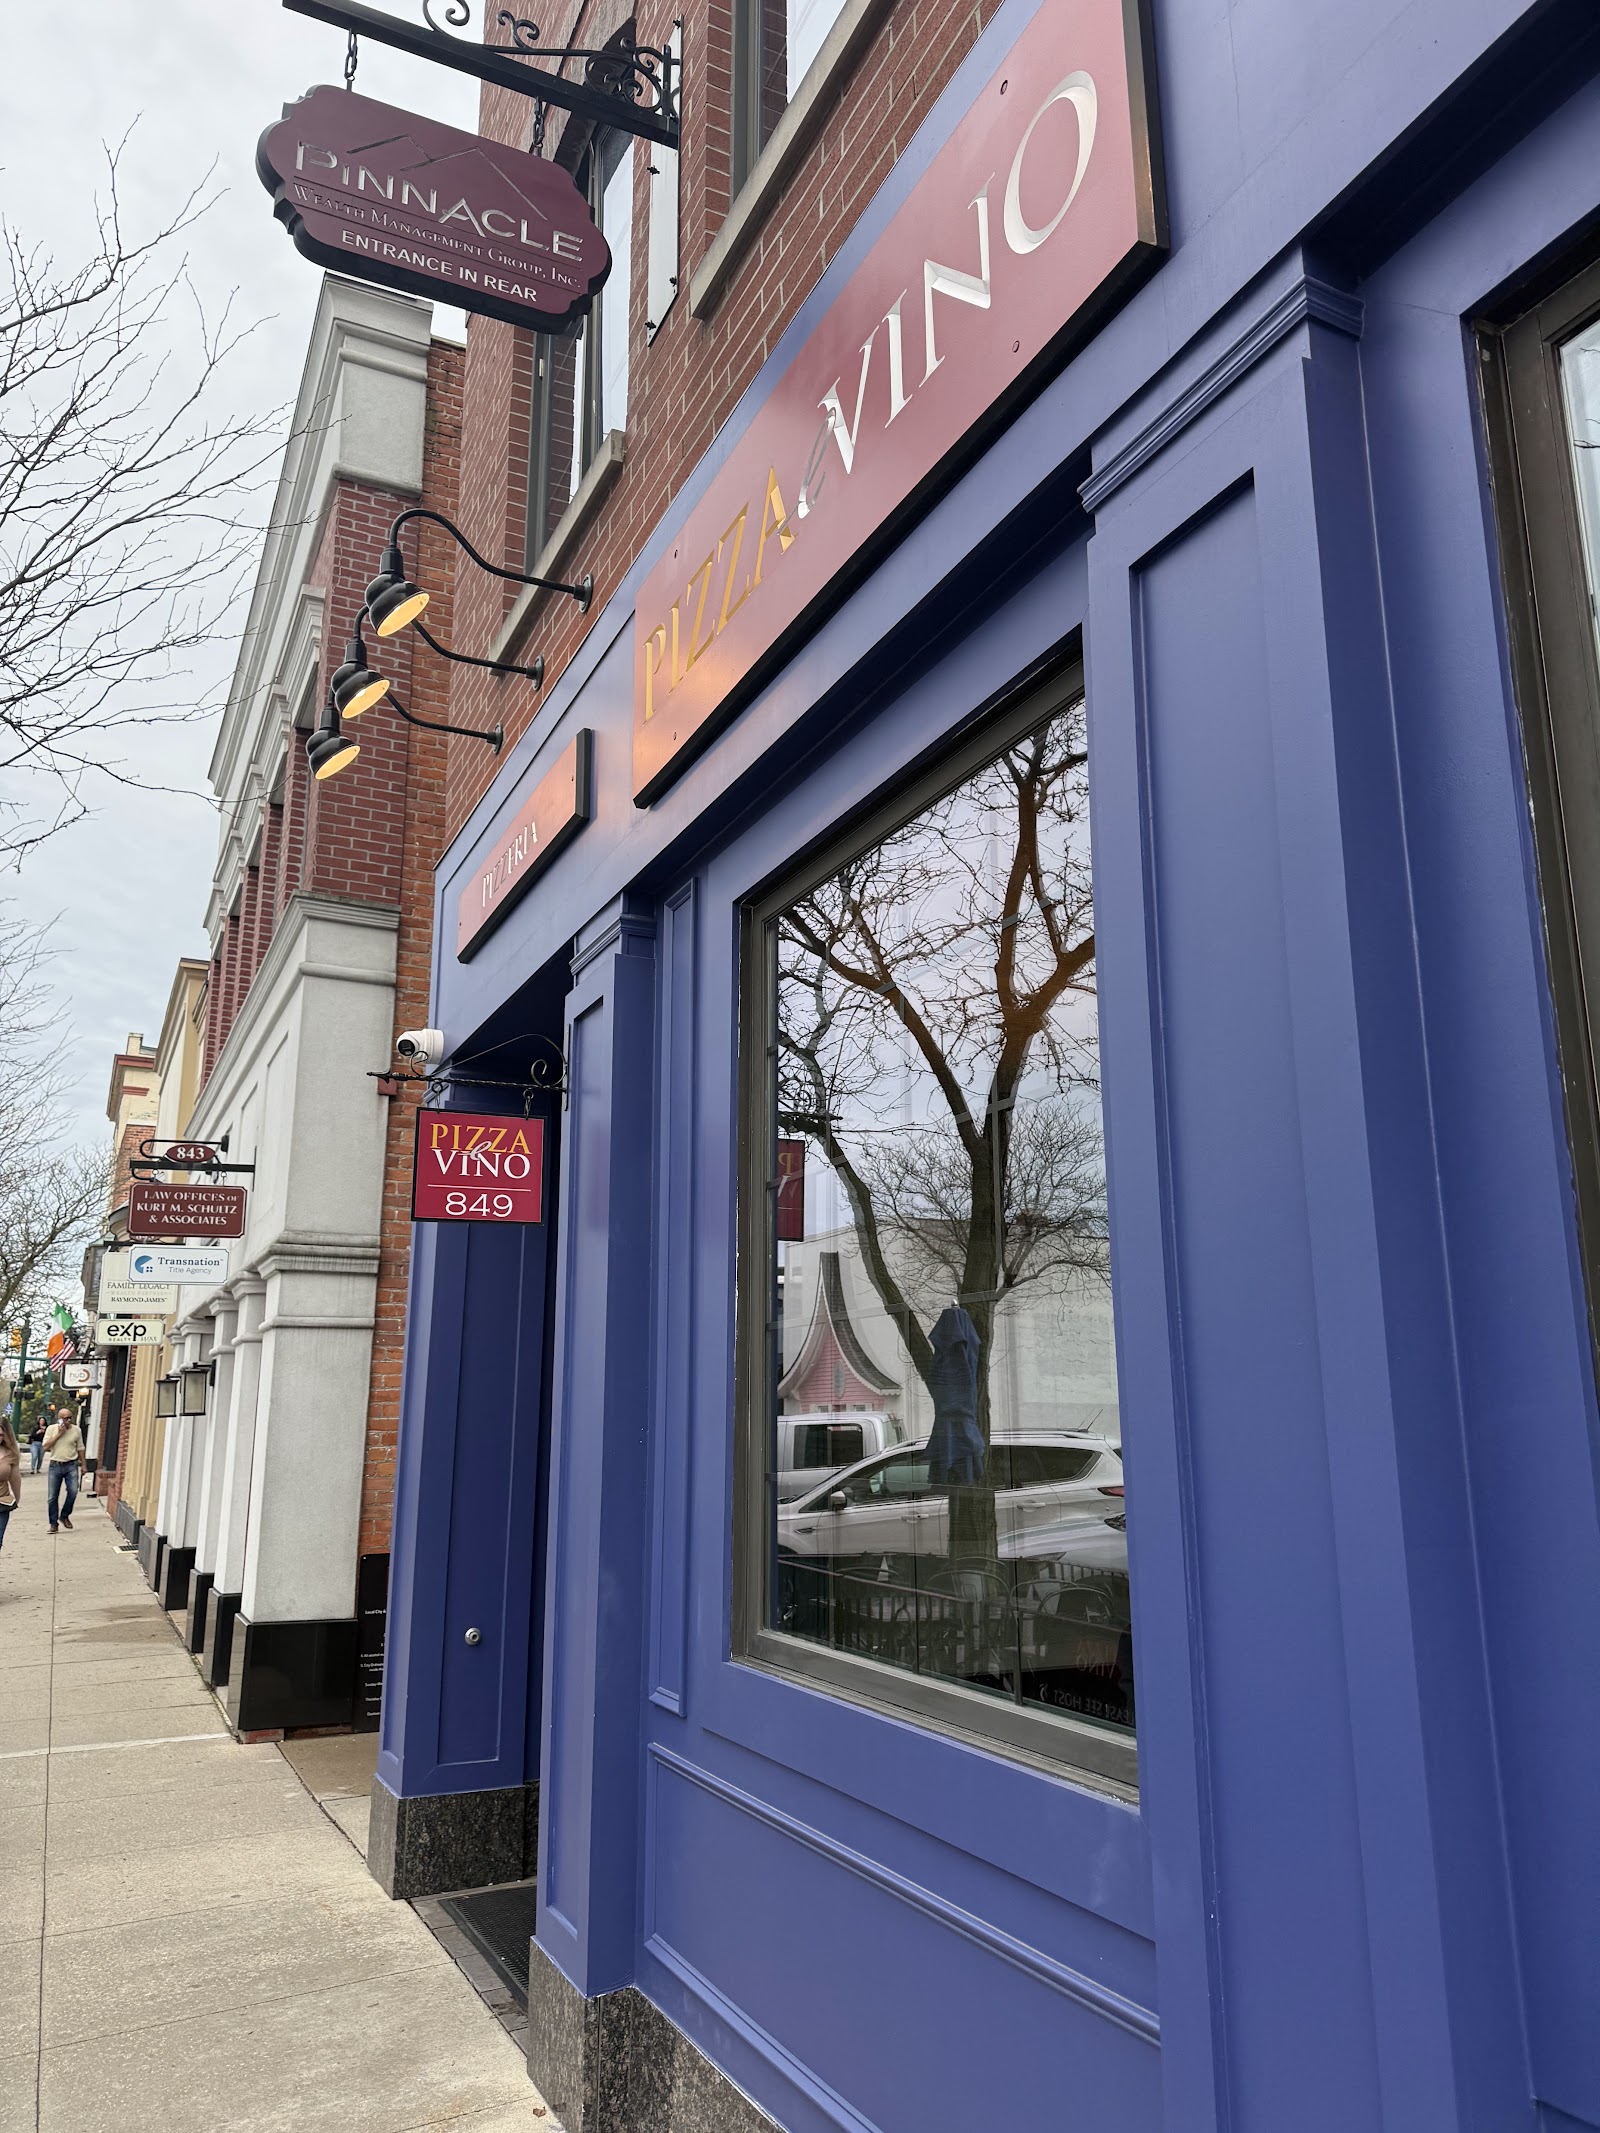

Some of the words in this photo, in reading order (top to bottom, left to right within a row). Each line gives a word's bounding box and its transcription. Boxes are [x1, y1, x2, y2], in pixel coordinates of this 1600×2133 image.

[296, 140, 583, 262] PINNACLE
[342, 229, 453, 276] ENTRANCE
[459, 266, 478, 284] IN
[484, 274, 537, 302] REAR
[640, 465, 799, 725] PIZZA
[817, 69, 1099, 475] VINO
[481, 815, 538, 907] PIZZERIA
[429, 1122, 533, 1155] PIZZA
[176, 1146, 205, 1160] 843
[432, 1148, 531, 1179] VINO
[136, 1202, 166, 1212] KURT
[170, 1203, 184, 1213] M.
[187, 1203, 238, 1214] SCHULTZ
[144, 1190, 172, 1200] LAW
[173, 1191, 225, 1202] OFFICES
[445, 1191, 513, 1218] 849
[148, 1214, 158, 1224] &
[161, 1214, 227, 1226] ASSOCIATES
[157, 1256, 220, 1267] Transnation
[185, 1267, 212, 1275] Agency
